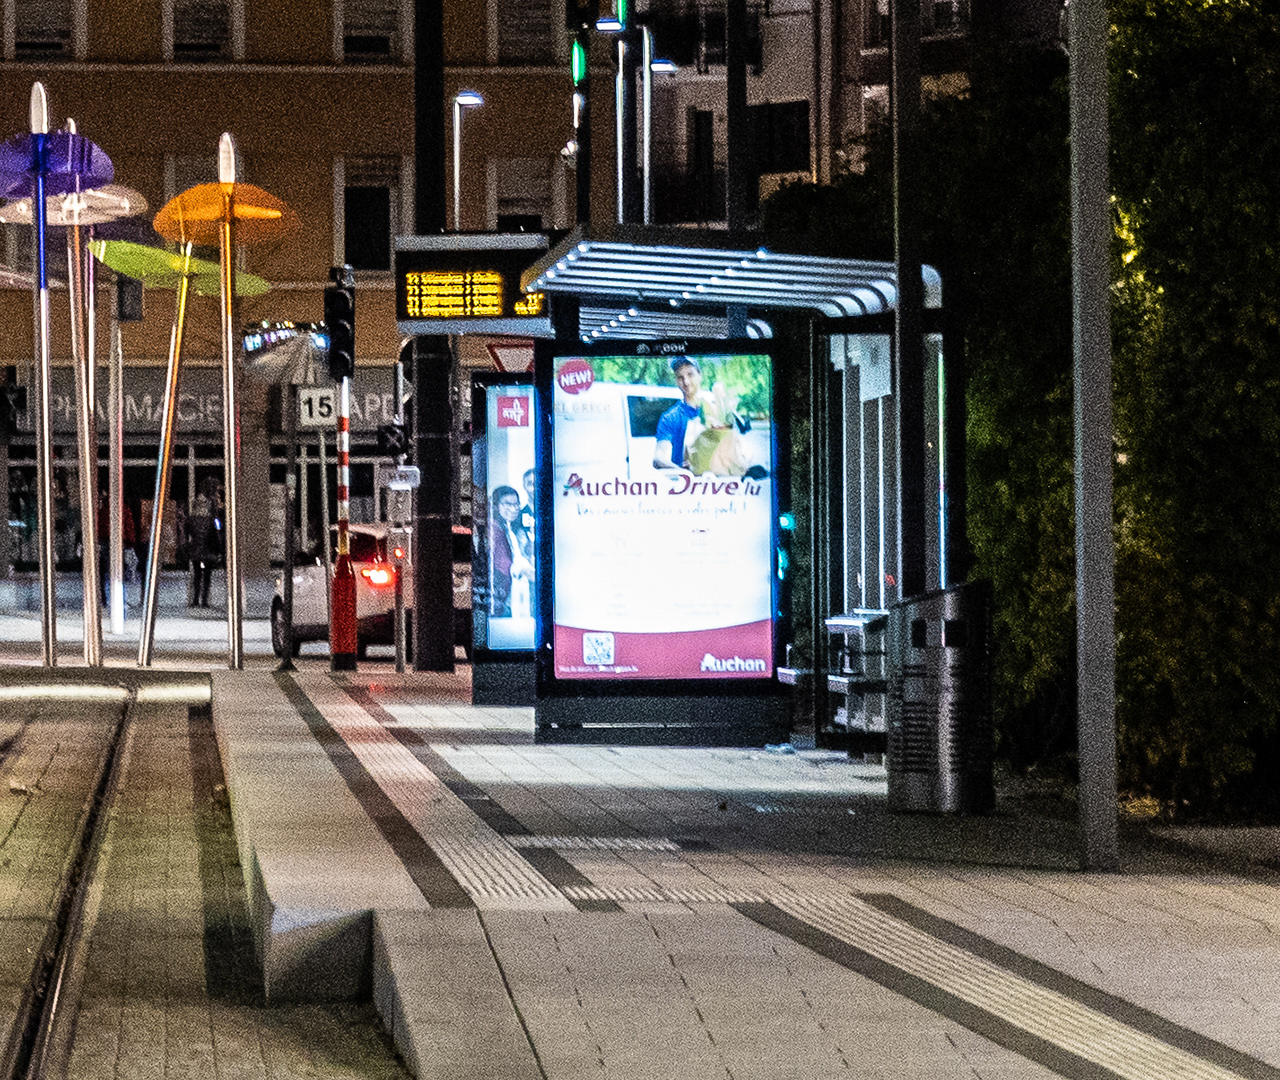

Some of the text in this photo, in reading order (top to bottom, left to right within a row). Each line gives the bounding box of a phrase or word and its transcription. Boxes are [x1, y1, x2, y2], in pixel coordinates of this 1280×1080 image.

[560, 370, 592, 387] NEW!
[302, 397, 333, 418] 15
[562, 473, 658, 496] Auchan
[700, 653, 766, 672] Auchan
